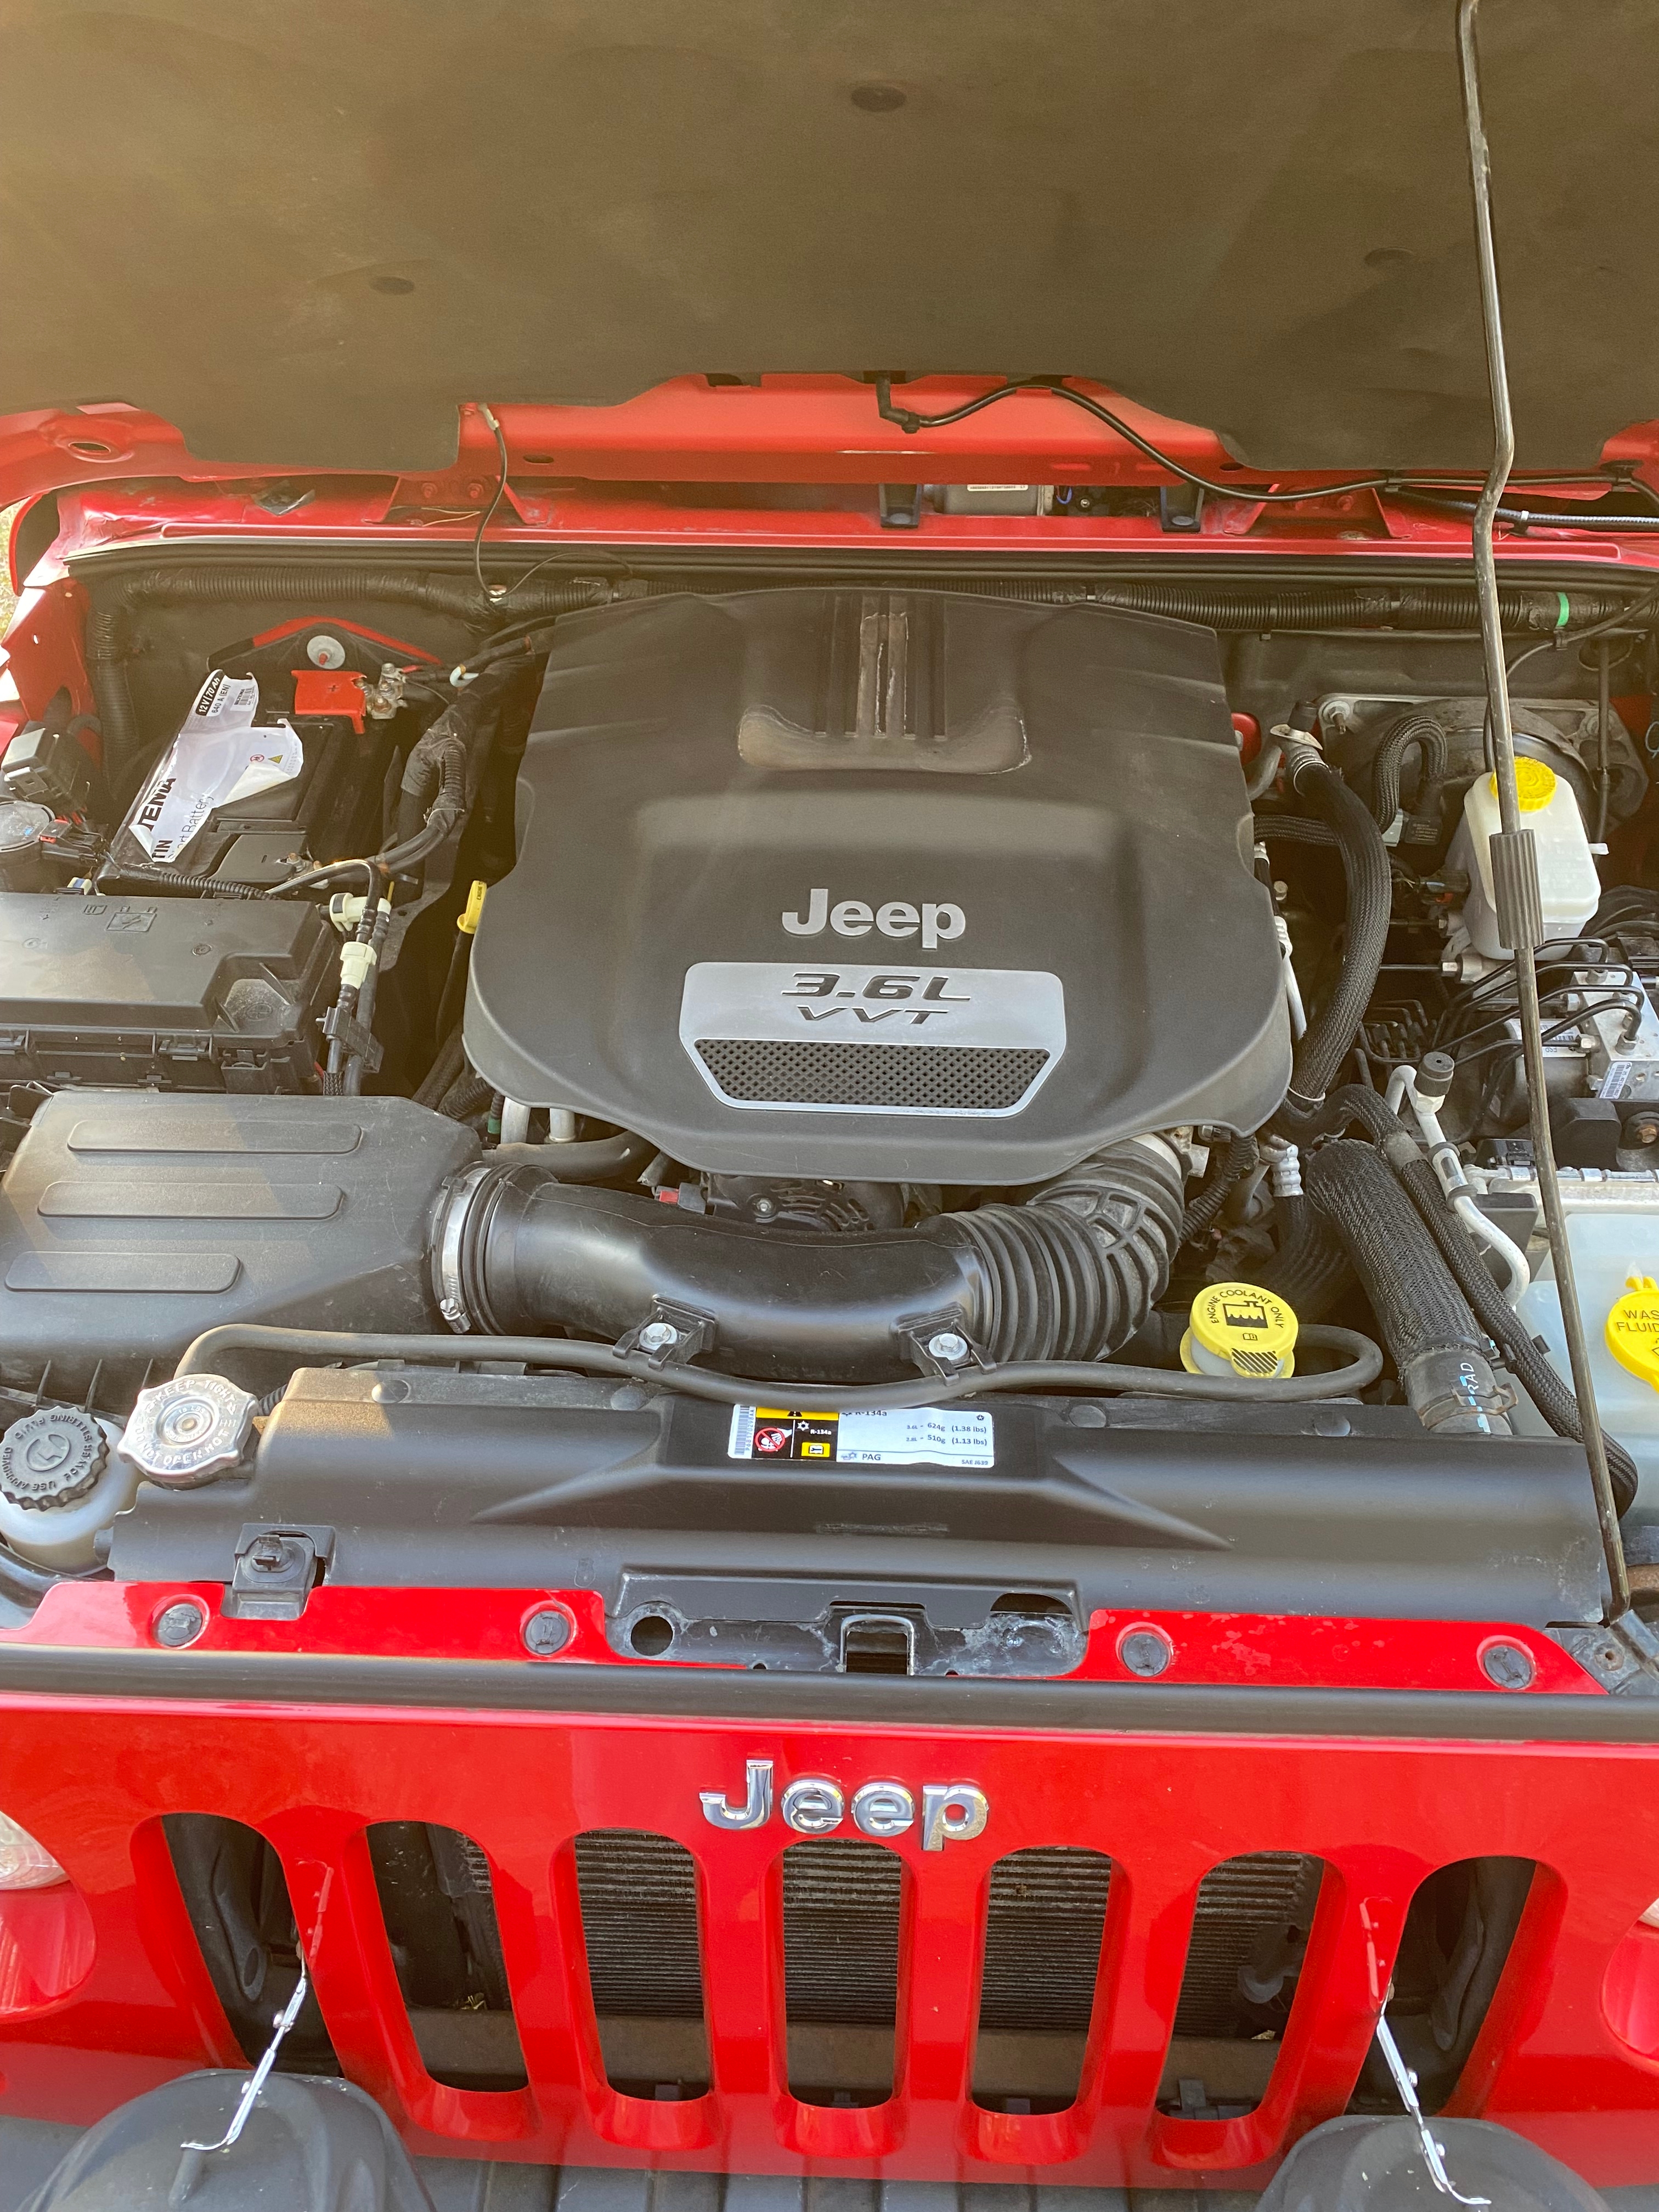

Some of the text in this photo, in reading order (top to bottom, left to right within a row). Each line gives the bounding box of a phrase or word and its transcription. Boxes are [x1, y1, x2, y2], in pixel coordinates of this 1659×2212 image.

[211, 703, 222, 713] 640
[782, 888, 966, 950] Jeep
[781, 972, 971, 1002] 3.6L
[796, 1005, 950, 1025] VVT
[1207, 1289, 1285, 1328] ENGINE COOLANT ONLY
[1460, 1362, 1479, 1395] RAD
[154, 1379, 196, 1401] KEEP
[927, 1423, 945, 1432] 624g
[951, 1425, 971, 1433] (1.38
[927, 1435, 946, 1444] 510g
[163, 1449, 204, 1465] OPEN
[699, 1759, 990, 1851] Jeep
